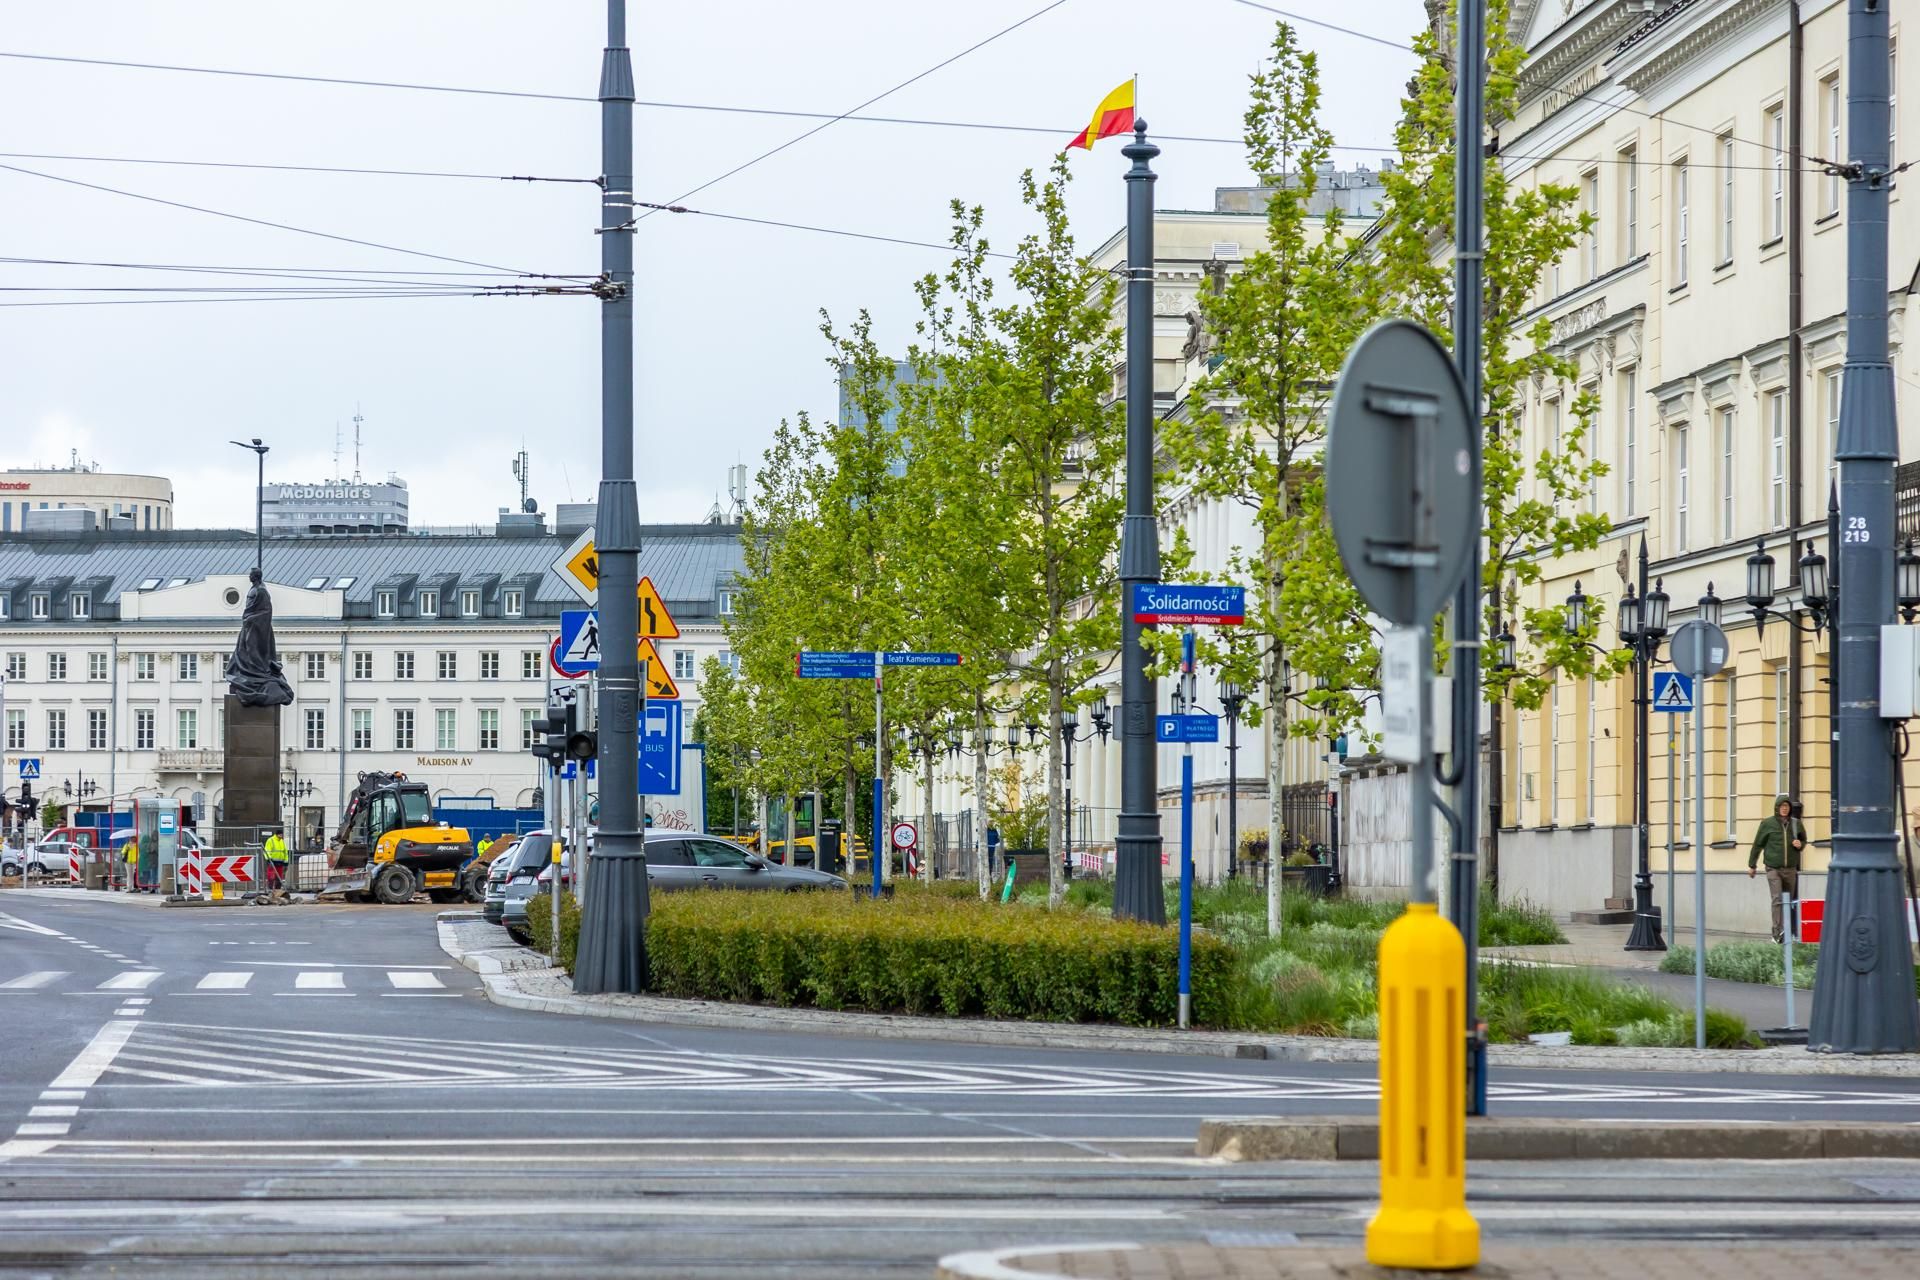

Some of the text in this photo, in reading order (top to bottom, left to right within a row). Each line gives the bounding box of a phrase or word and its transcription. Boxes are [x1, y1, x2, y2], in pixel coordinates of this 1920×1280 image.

[280, 487, 371, 499] McDonald's
[1848, 516, 1867, 530] 28
[1844, 530, 1870, 543] 219
[1141, 586, 1156, 594] Aleja
[1158, 614, 1221, 624] Śródmieście Północne
[888, 654, 904, 663] Teatr
[906, 654, 940, 663] Kamienica
[1164, 722, 1175, 736] P
[645, 744, 665, 753] BUS
